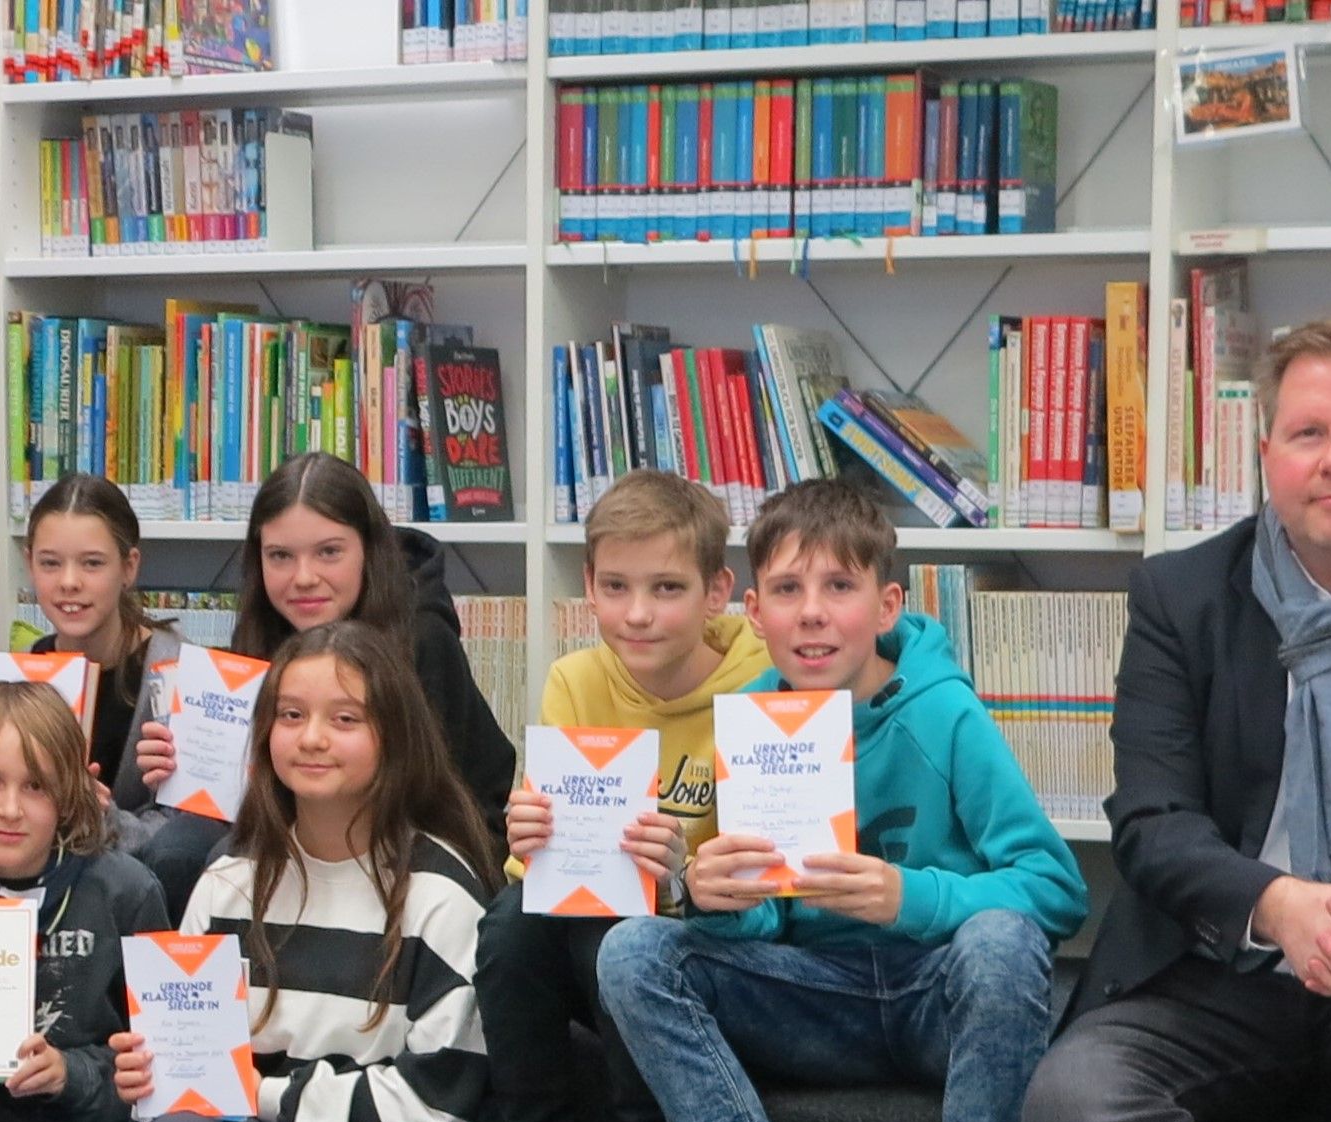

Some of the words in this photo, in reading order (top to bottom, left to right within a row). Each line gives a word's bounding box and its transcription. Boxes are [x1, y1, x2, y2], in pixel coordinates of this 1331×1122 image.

[59, 329, 71, 420] DINOSAURIER
[444, 398, 496, 440] BOYS
[1113, 406, 1122, 436] UND
[336, 417, 347, 454] BIOL
[445, 434, 503, 466] DARE
[447, 464, 505, 492] DIFFERENT
[752, 742, 816, 755] URKUNDE
[731, 753, 786, 766] KLASSEN
[540, 784, 593, 796] KLASSEN
[562, 775, 623, 787] URKUNDE
[159, 981, 213, 992] URKUNDE
[141, 992, 189, 1002] KLASSEN
